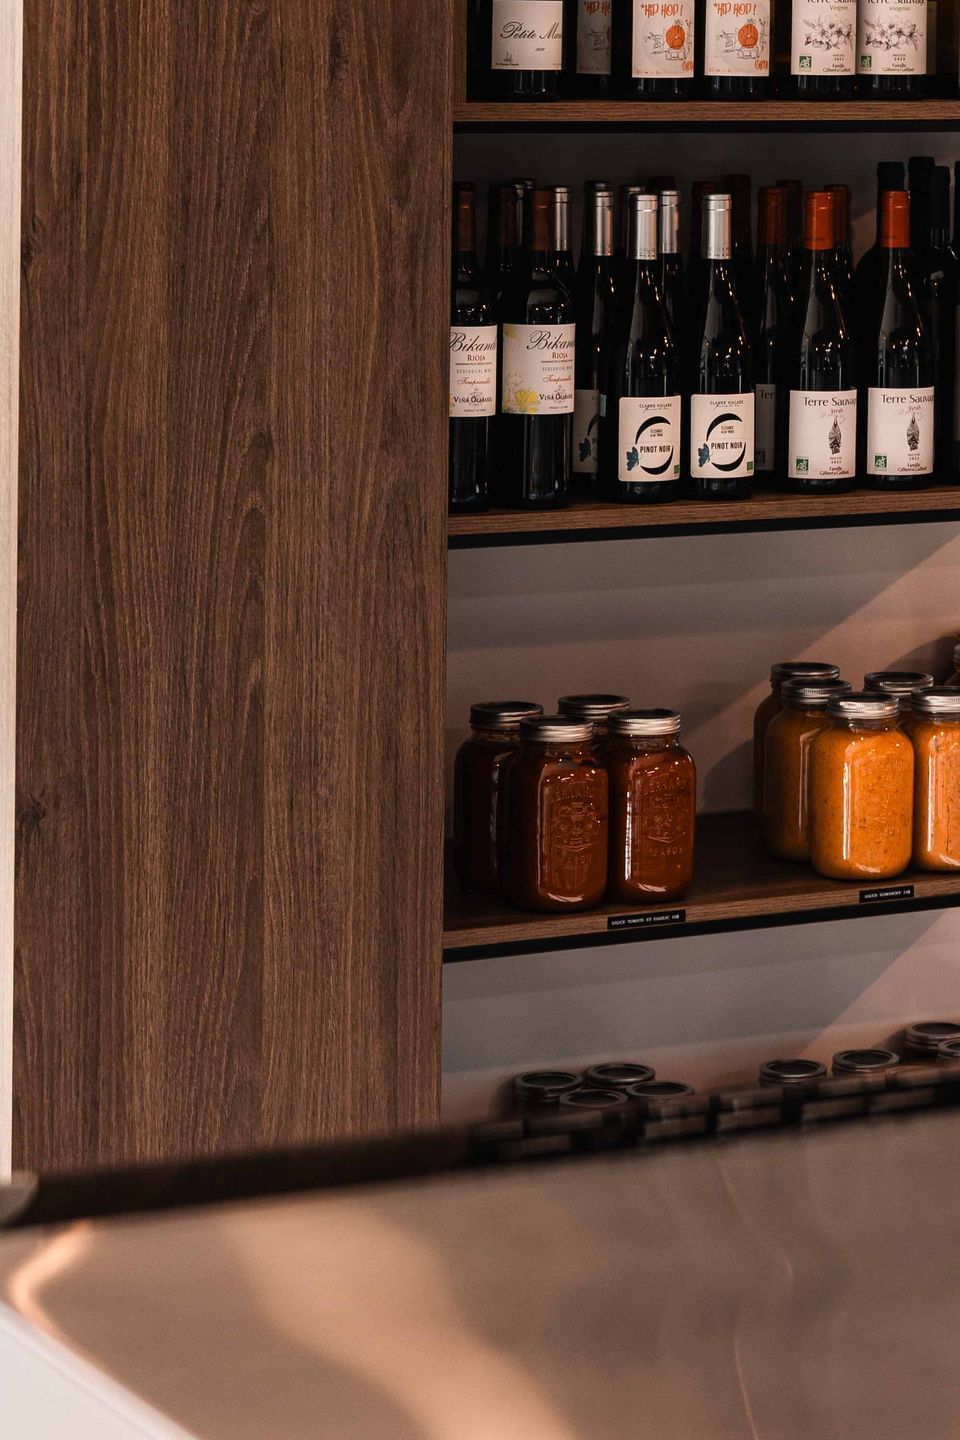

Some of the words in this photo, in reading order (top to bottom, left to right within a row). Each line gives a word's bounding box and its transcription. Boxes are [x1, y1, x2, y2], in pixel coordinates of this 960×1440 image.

[500, 21, 537, 39] Petite
[467, 354, 486, 362] RIOJA
[802, 397, 829, 407] Terre
[881, 394, 907, 404] Terre
[640, 445, 657, 453] PINOT
[659, 445, 671, 453] NOIR
